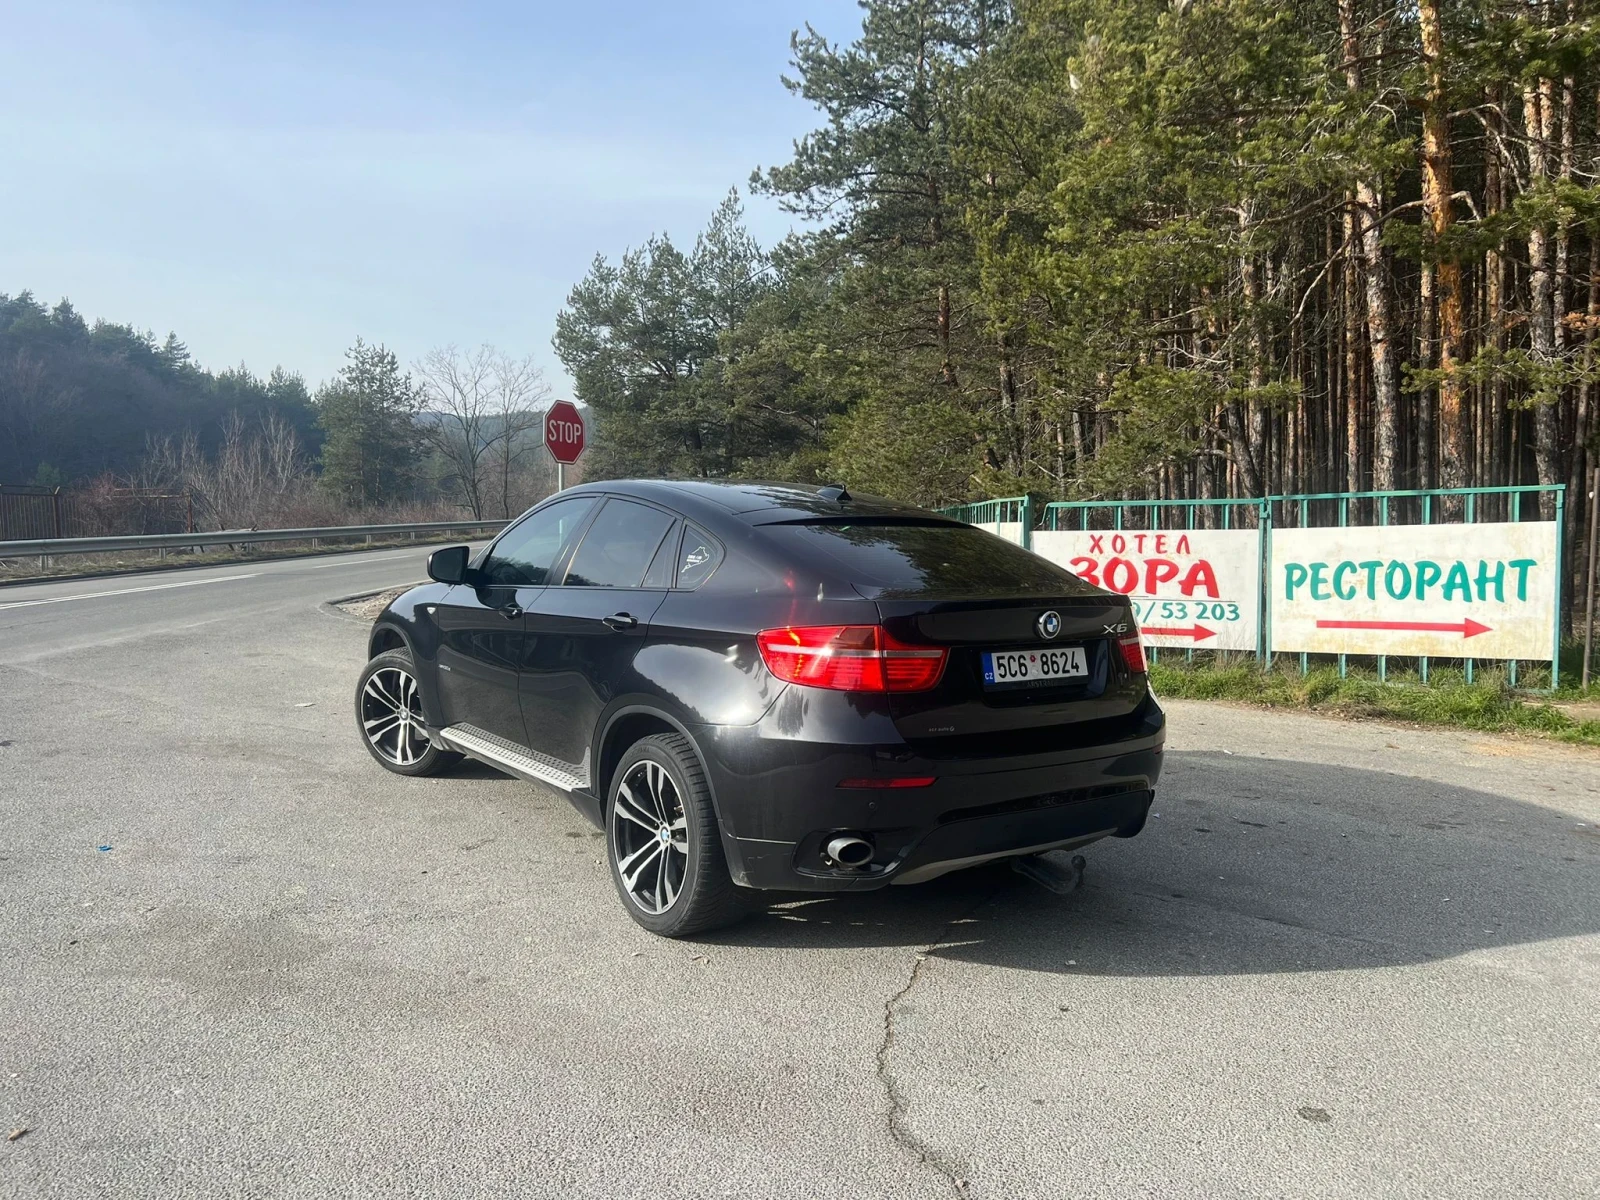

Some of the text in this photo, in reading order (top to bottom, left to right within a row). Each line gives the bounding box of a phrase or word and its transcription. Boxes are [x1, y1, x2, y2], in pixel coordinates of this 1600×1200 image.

[548, 419, 582, 444] STOP
[1088, 533, 1192, 555] ХОТЕЛ
[1069, 555, 1221, 599] ЗОРА
[1284, 558, 1538, 604] РЕСТОРАНТ
[1196, 602, 1240, 622] 203
[1102, 623, 1128, 635] X6
[984, 672, 994, 680] CZ
[996, 651, 1080, 679] 5C6 8624
